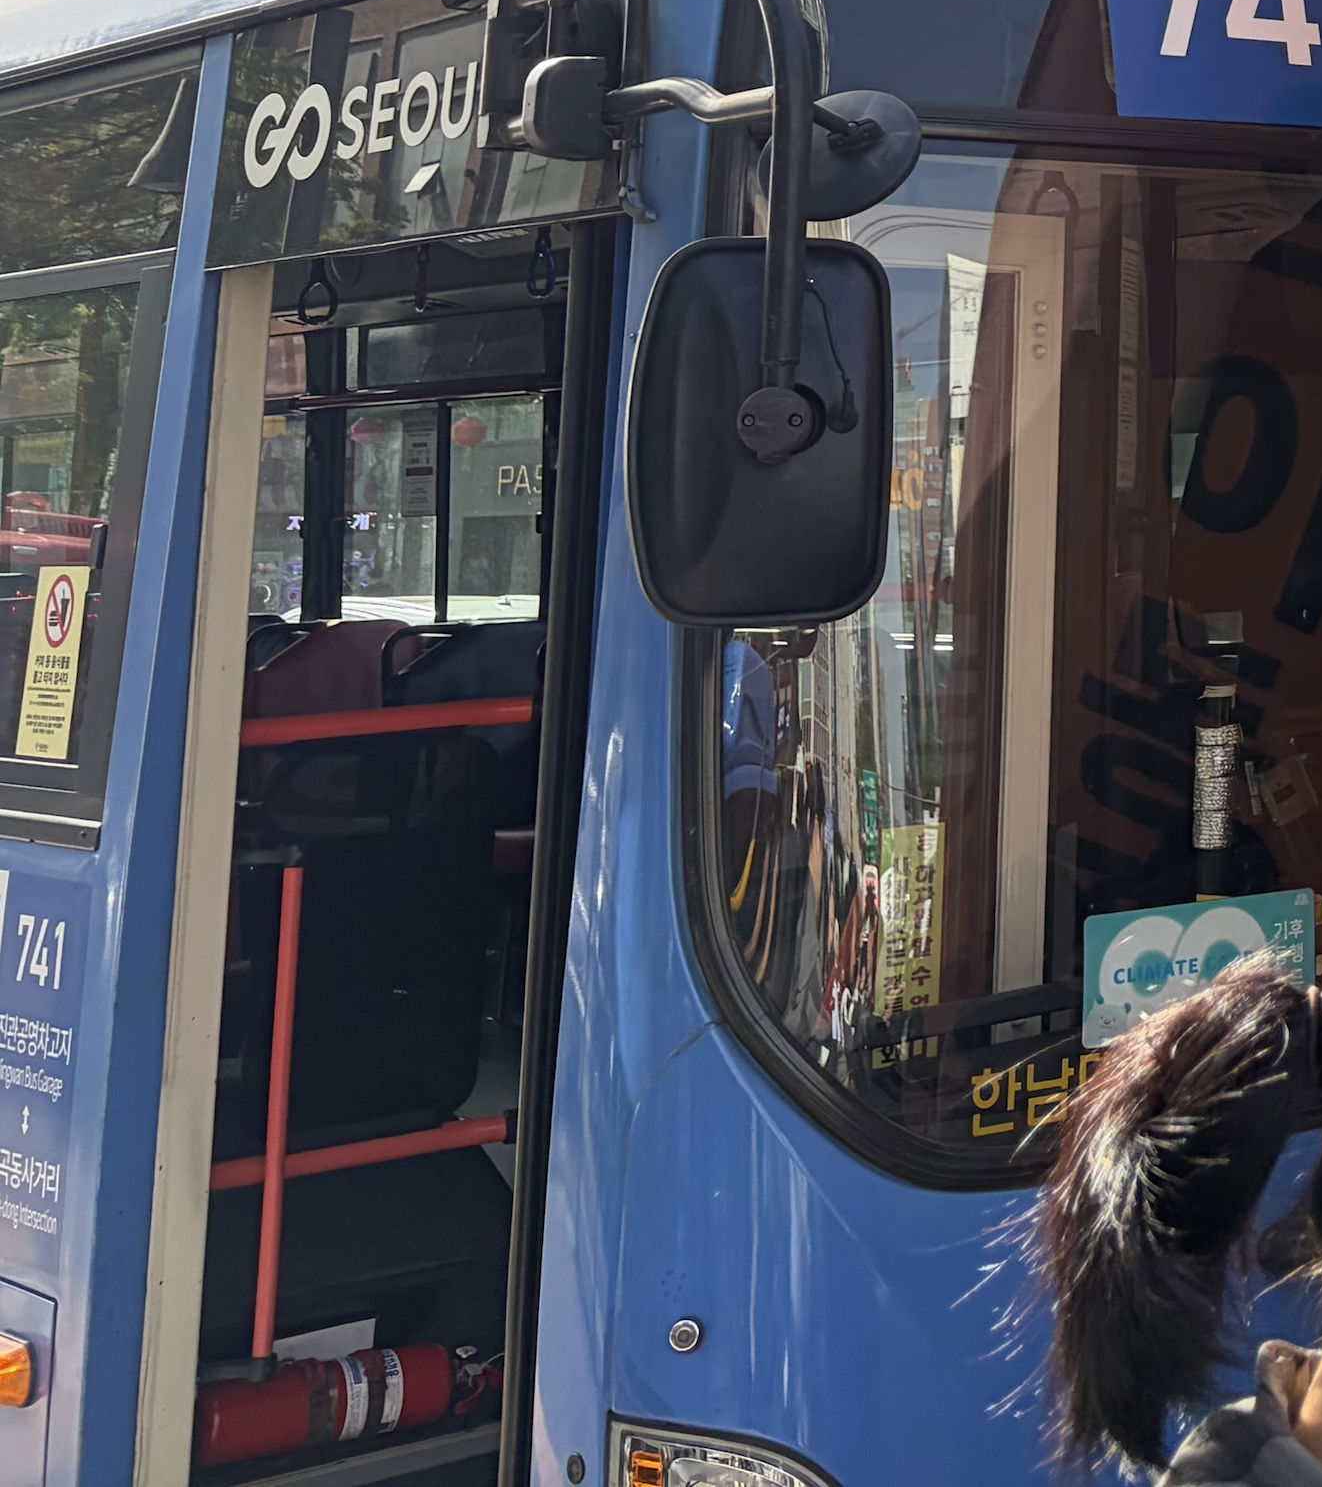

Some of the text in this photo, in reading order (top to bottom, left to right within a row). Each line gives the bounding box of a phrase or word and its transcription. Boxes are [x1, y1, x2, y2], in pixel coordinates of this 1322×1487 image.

[243, 83, 332, 189] GO
[15, 913, 66, 990] 741
[1273, 918, 1304, 942] 기후
[1112, 956, 1199, 986] CLIMATE
